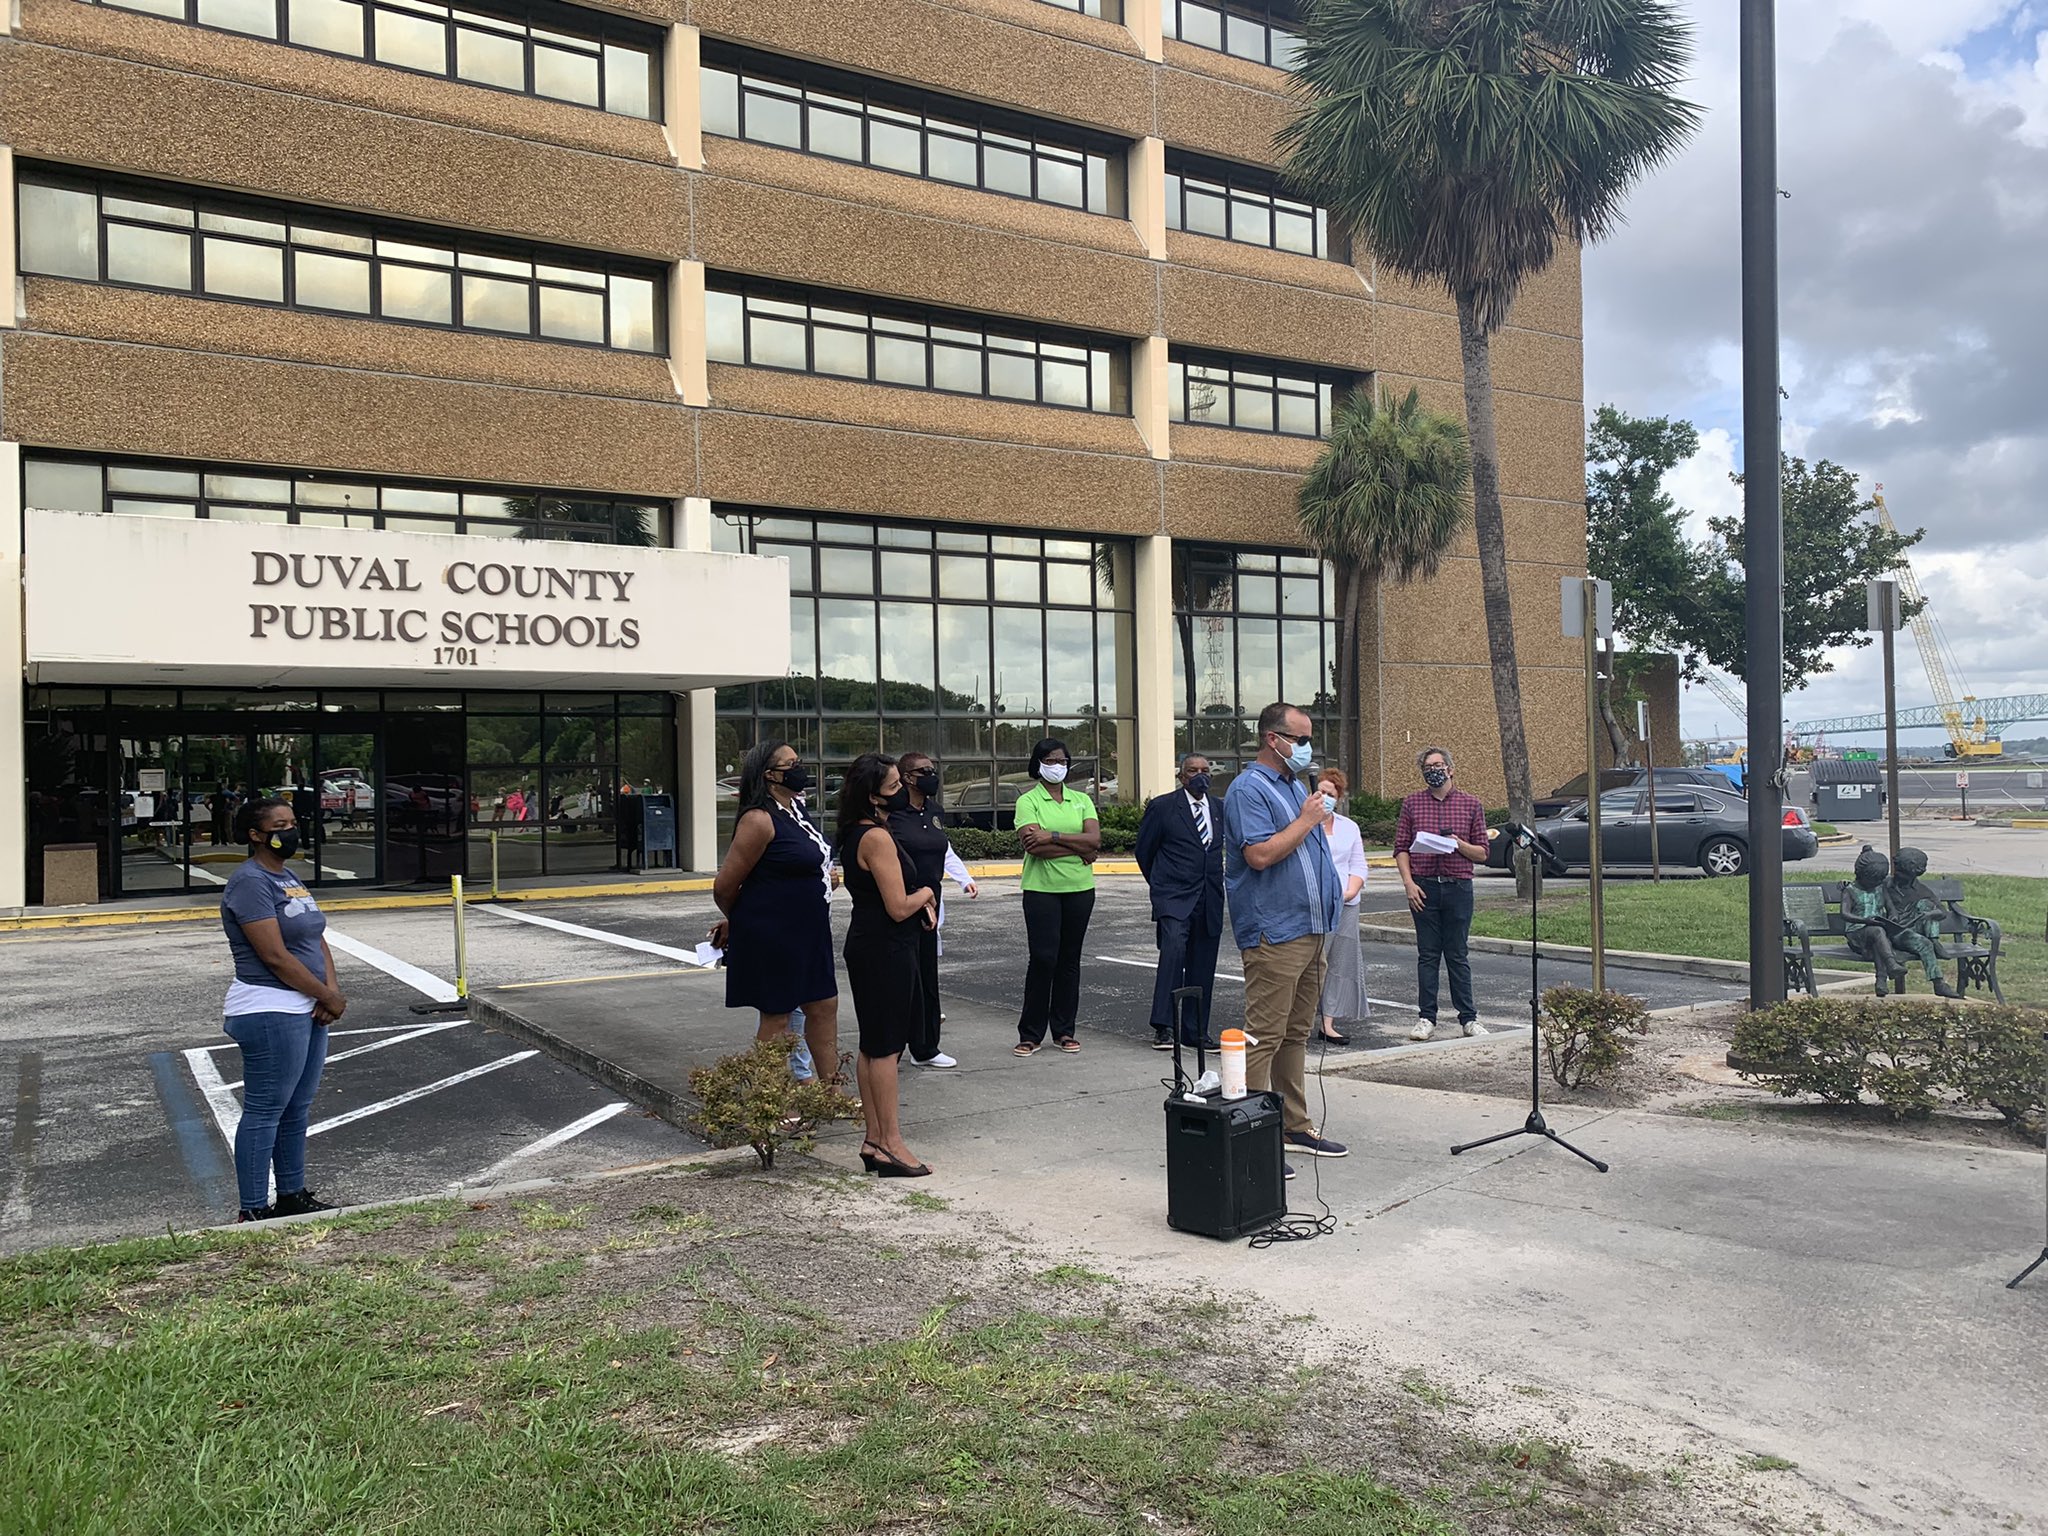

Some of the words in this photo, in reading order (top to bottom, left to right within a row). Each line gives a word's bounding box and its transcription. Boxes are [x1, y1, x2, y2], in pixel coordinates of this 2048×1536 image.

[251, 551, 422, 592] DUVAL
[446, 561, 635, 603] COUNTY
[249, 603, 428, 643] PUBLIC
[441, 610, 640, 649] SCHOOLS
[433, 646, 478, 666] 1701
